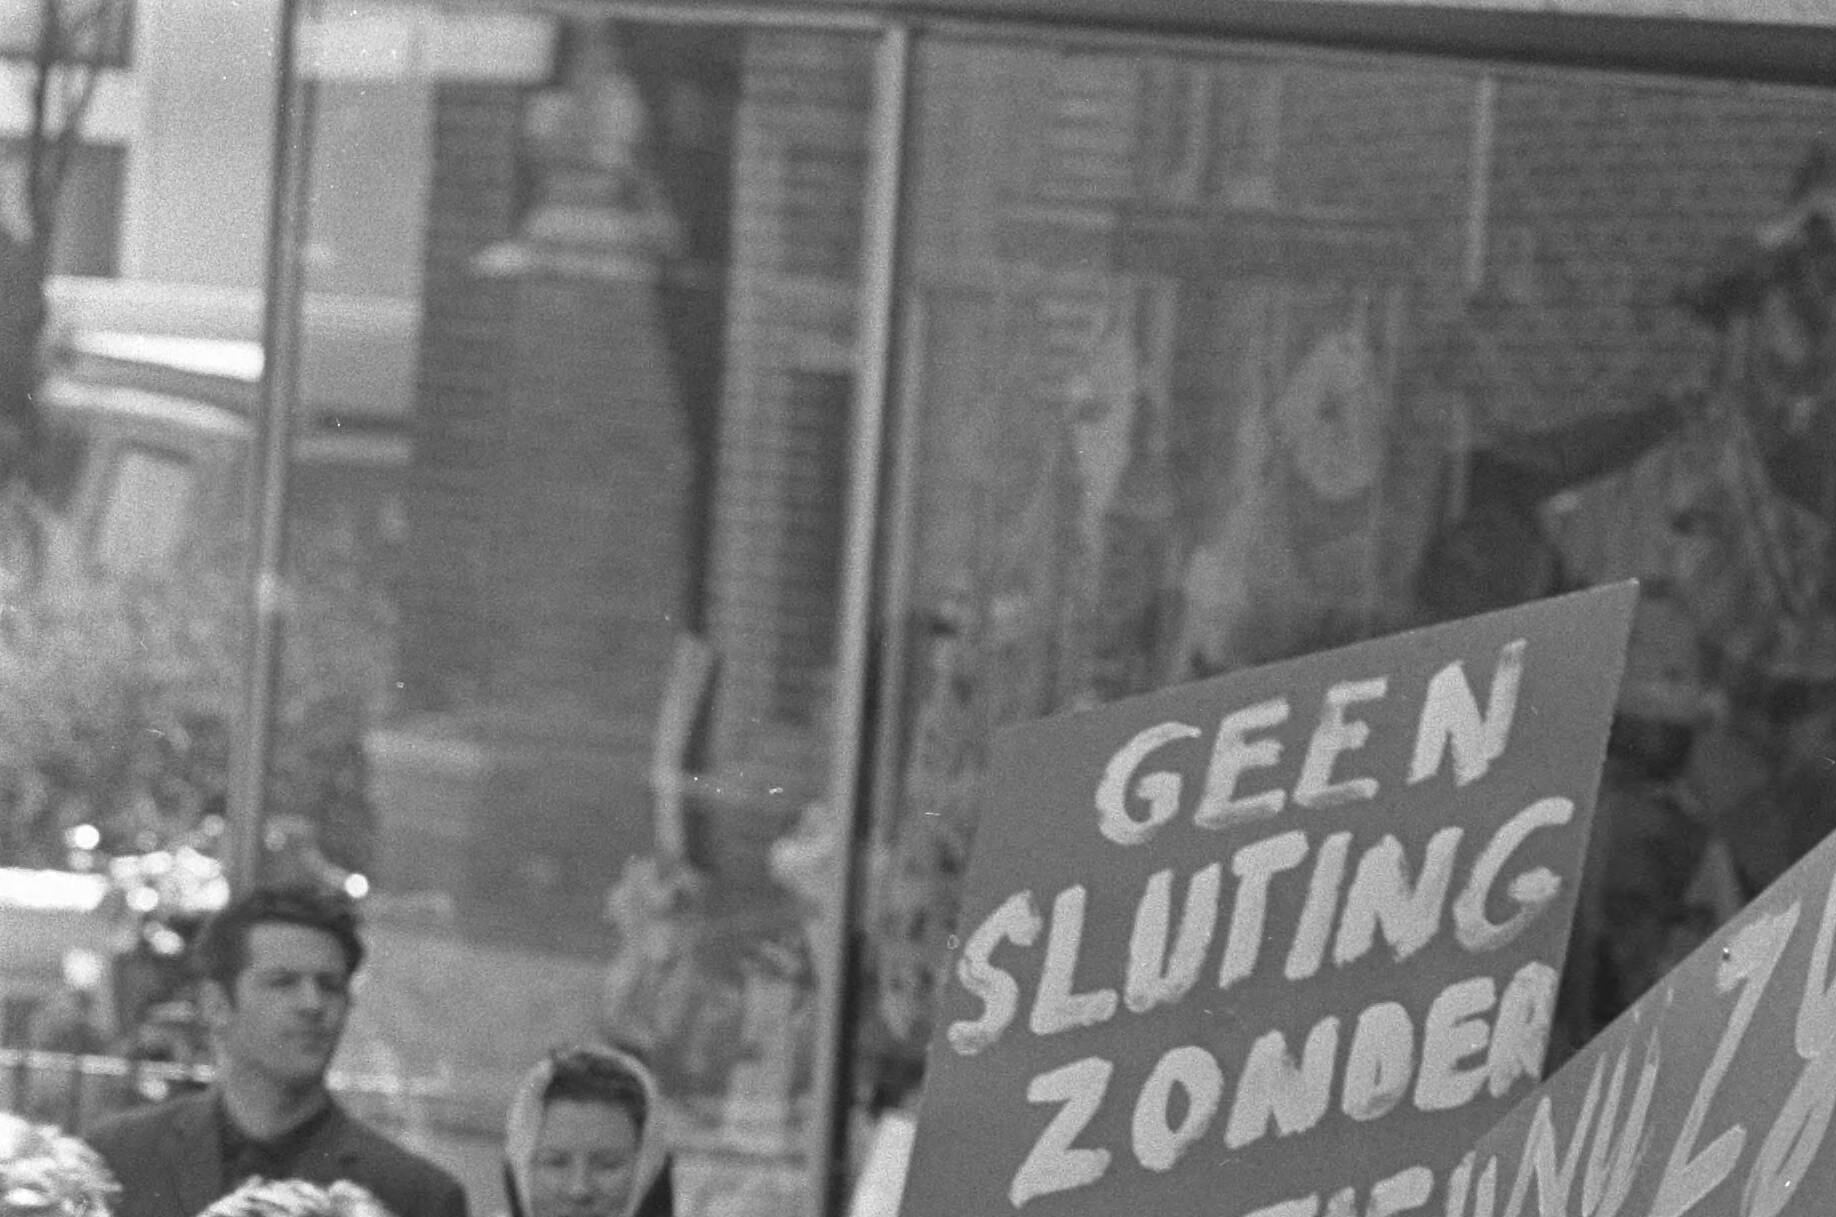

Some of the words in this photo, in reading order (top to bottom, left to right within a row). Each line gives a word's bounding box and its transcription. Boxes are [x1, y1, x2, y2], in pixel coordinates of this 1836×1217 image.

[1095, 638, 1527, 844] GEEN
[948, 797, 1573, 1056] SLUTING
[1010, 961, 1558, 1207] ZONDER
